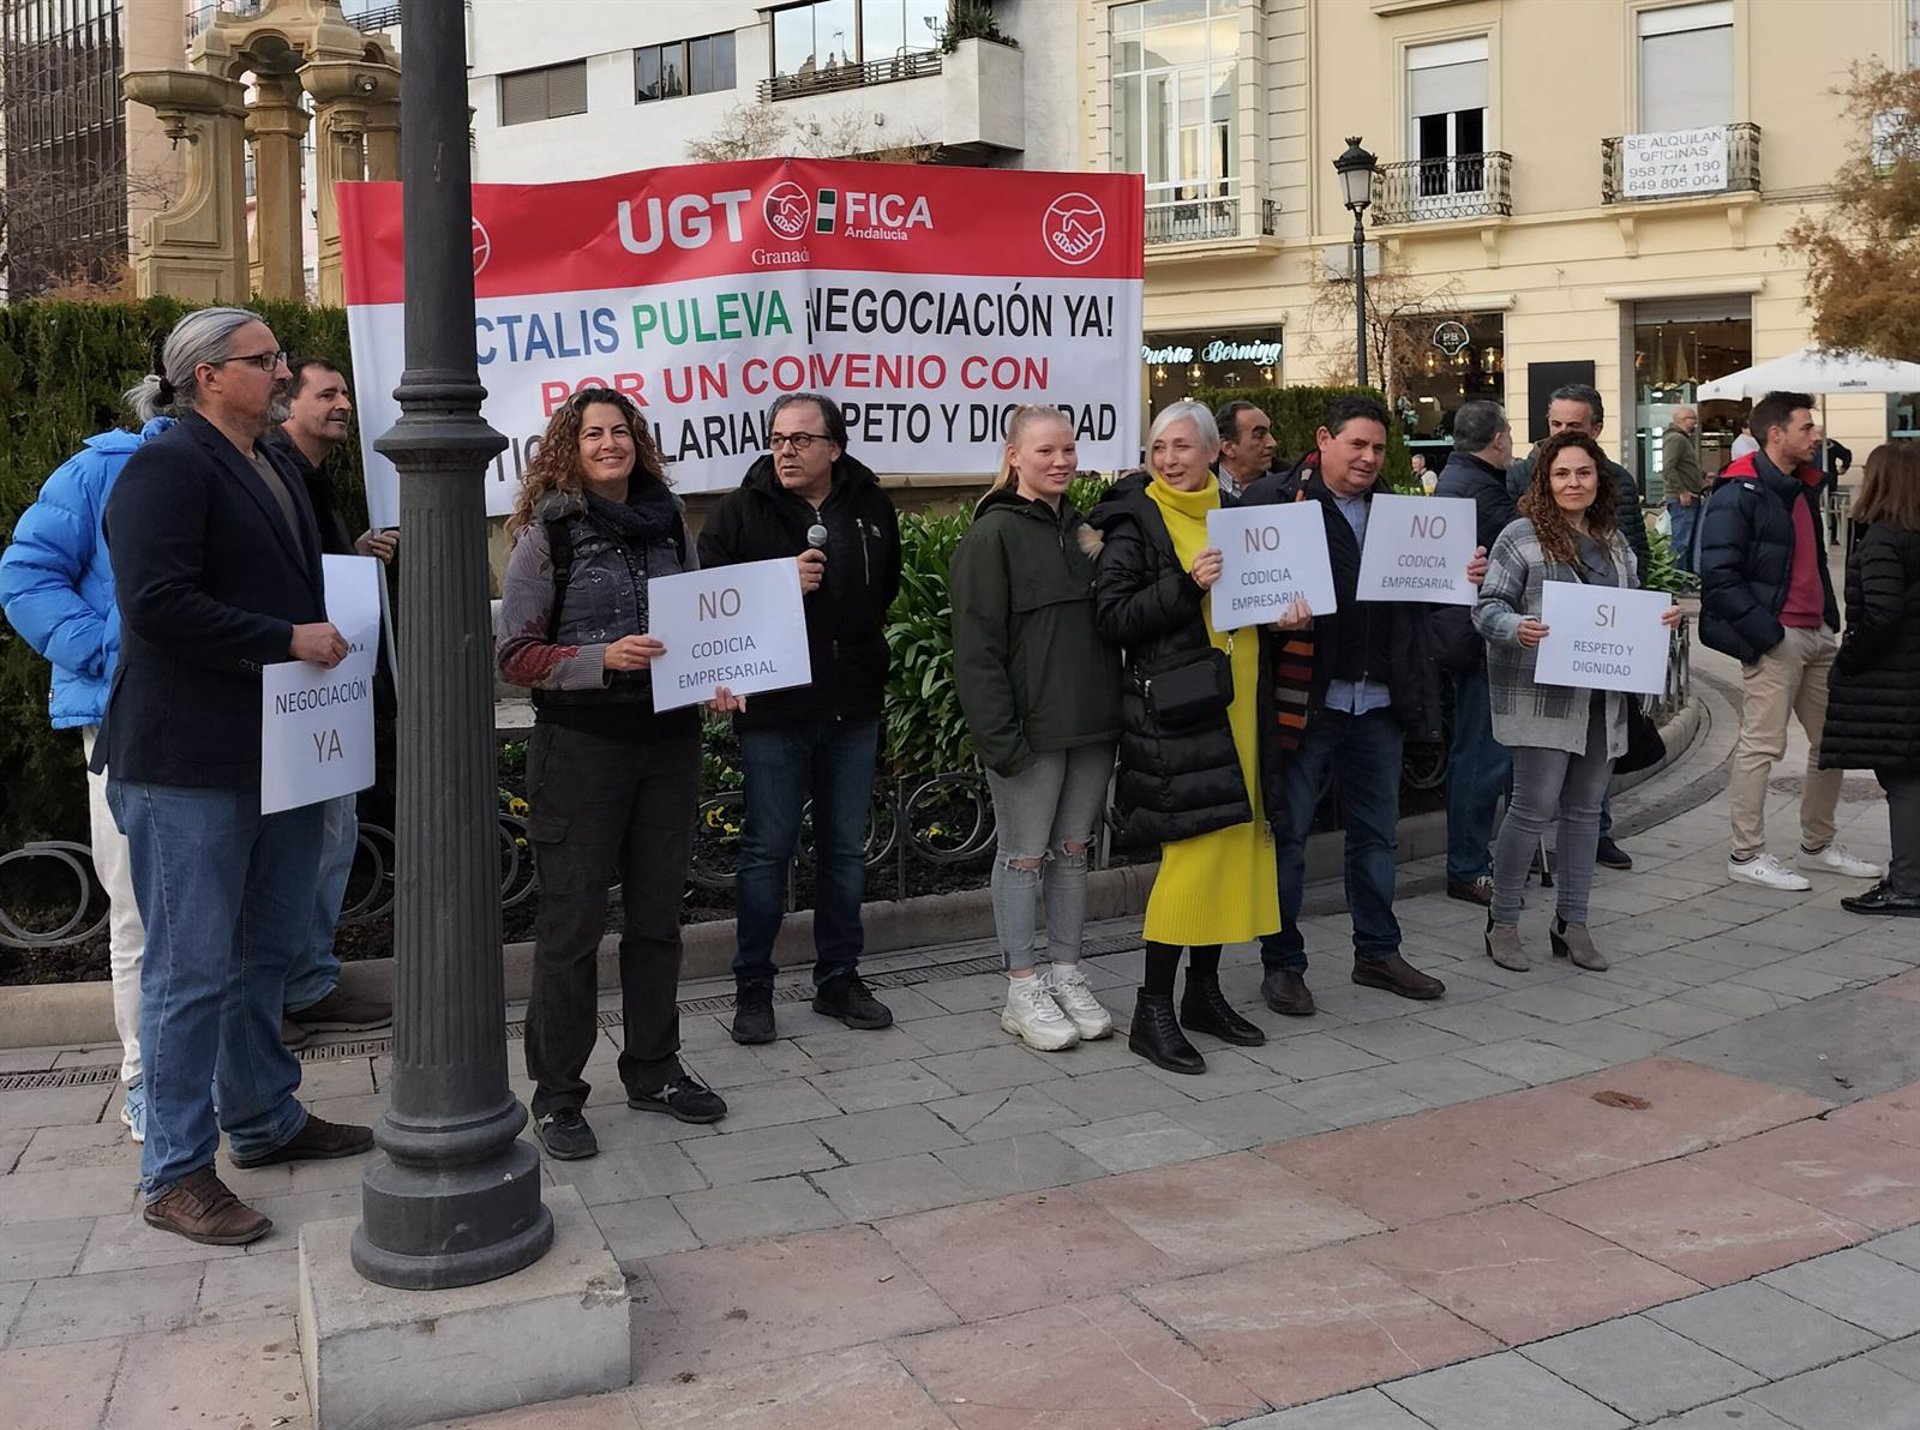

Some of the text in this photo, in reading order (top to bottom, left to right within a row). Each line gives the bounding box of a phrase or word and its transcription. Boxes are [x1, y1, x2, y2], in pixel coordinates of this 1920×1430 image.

[1628, 130, 1722, 150] SE ALQUILAN
[1640, 146, 1709, 162] OFICINAS
[1629, 166, 1656, 178] 958
[1661, 164, 1687, 175] 774
[1629, 173, 1719, 191] 649 805 004
[617, 189, 752, 255] UGT
[845, 192, 933, 229] FICA
[845, 227, 908, 241] Andalucía
[752, 245, 810, 266] Granad
[475, 307, 620, 366] CTALIS
[632, 290, 793, 349] PULEVA
[1063, 295, 1114, 337] YA!
[663, 363, 728, 404] UN
[742, 352, 946, 396] CONVENIO
[960, 356, 1049, 391] CON
[654, 409, 771, 463] LARIAL
[841, 402, 930, 443] PETO
[940, 403, 960, 443] Y
[1244, 526, 1280, 553] NO
[1410, 515, 1447, 540] NO
[1397, 554, 1447, 568] CODICIA
[1241, 568, 1292, 586] CODICIA
[1382, 576, 1456, 591] EMPRESARIAL
[699, 588, 742, 622] NO
[1595, 604, 1616, 628] SI
[691, 635, 757, 660] CODICIA
[1573, 640, 1635, 656] RESPETO Y
[678, 659, 778, 690] EMPRESARIAL
[1572, 660, 1632, 677] DIGNIDAD
[275, 676, 367, 715] NEGOCIACIÓN
[313, 729, 343, 764] YA
